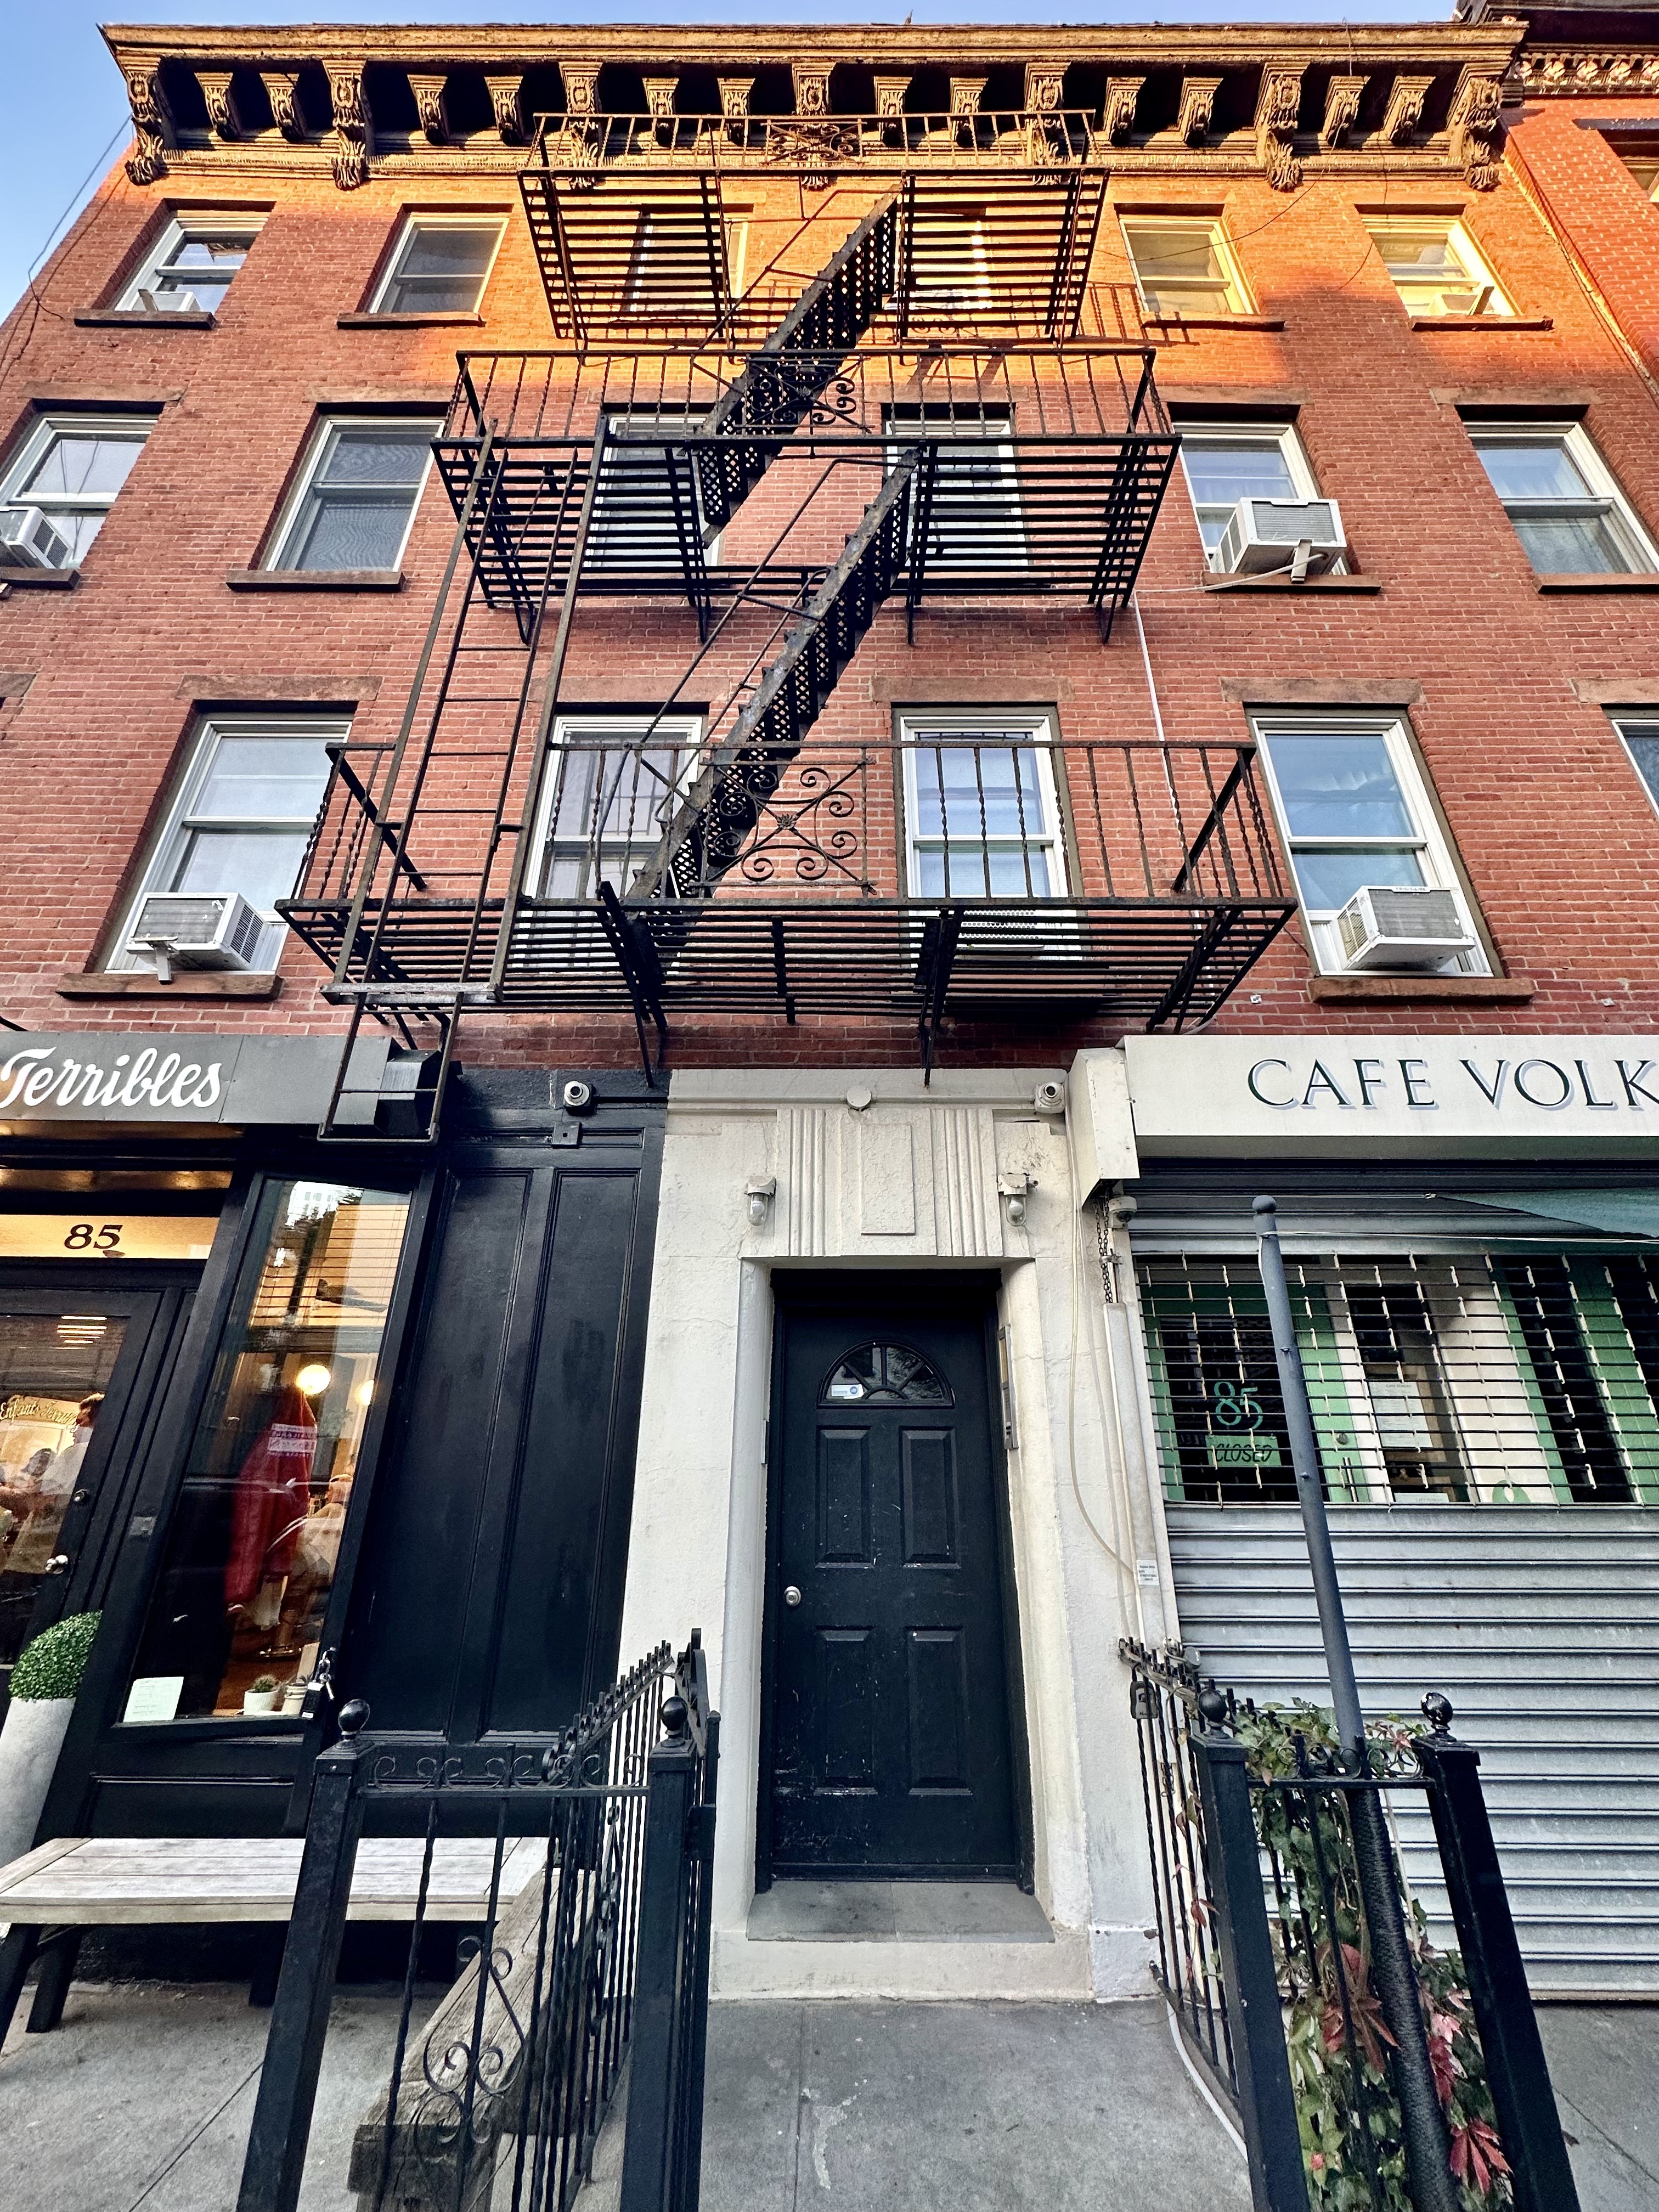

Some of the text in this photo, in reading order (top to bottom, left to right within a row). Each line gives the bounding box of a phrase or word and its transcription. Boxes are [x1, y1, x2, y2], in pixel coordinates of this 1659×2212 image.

[0, 1046, 222, 1109] Terribles
[1248, 1058, 1659, 1110] CAFE VOLK
[64, 1224, 123, 1249] 85
[1214, 1381, 1263, 1430] 85
[1216, 1443, 1273, 1462] CLOSED
